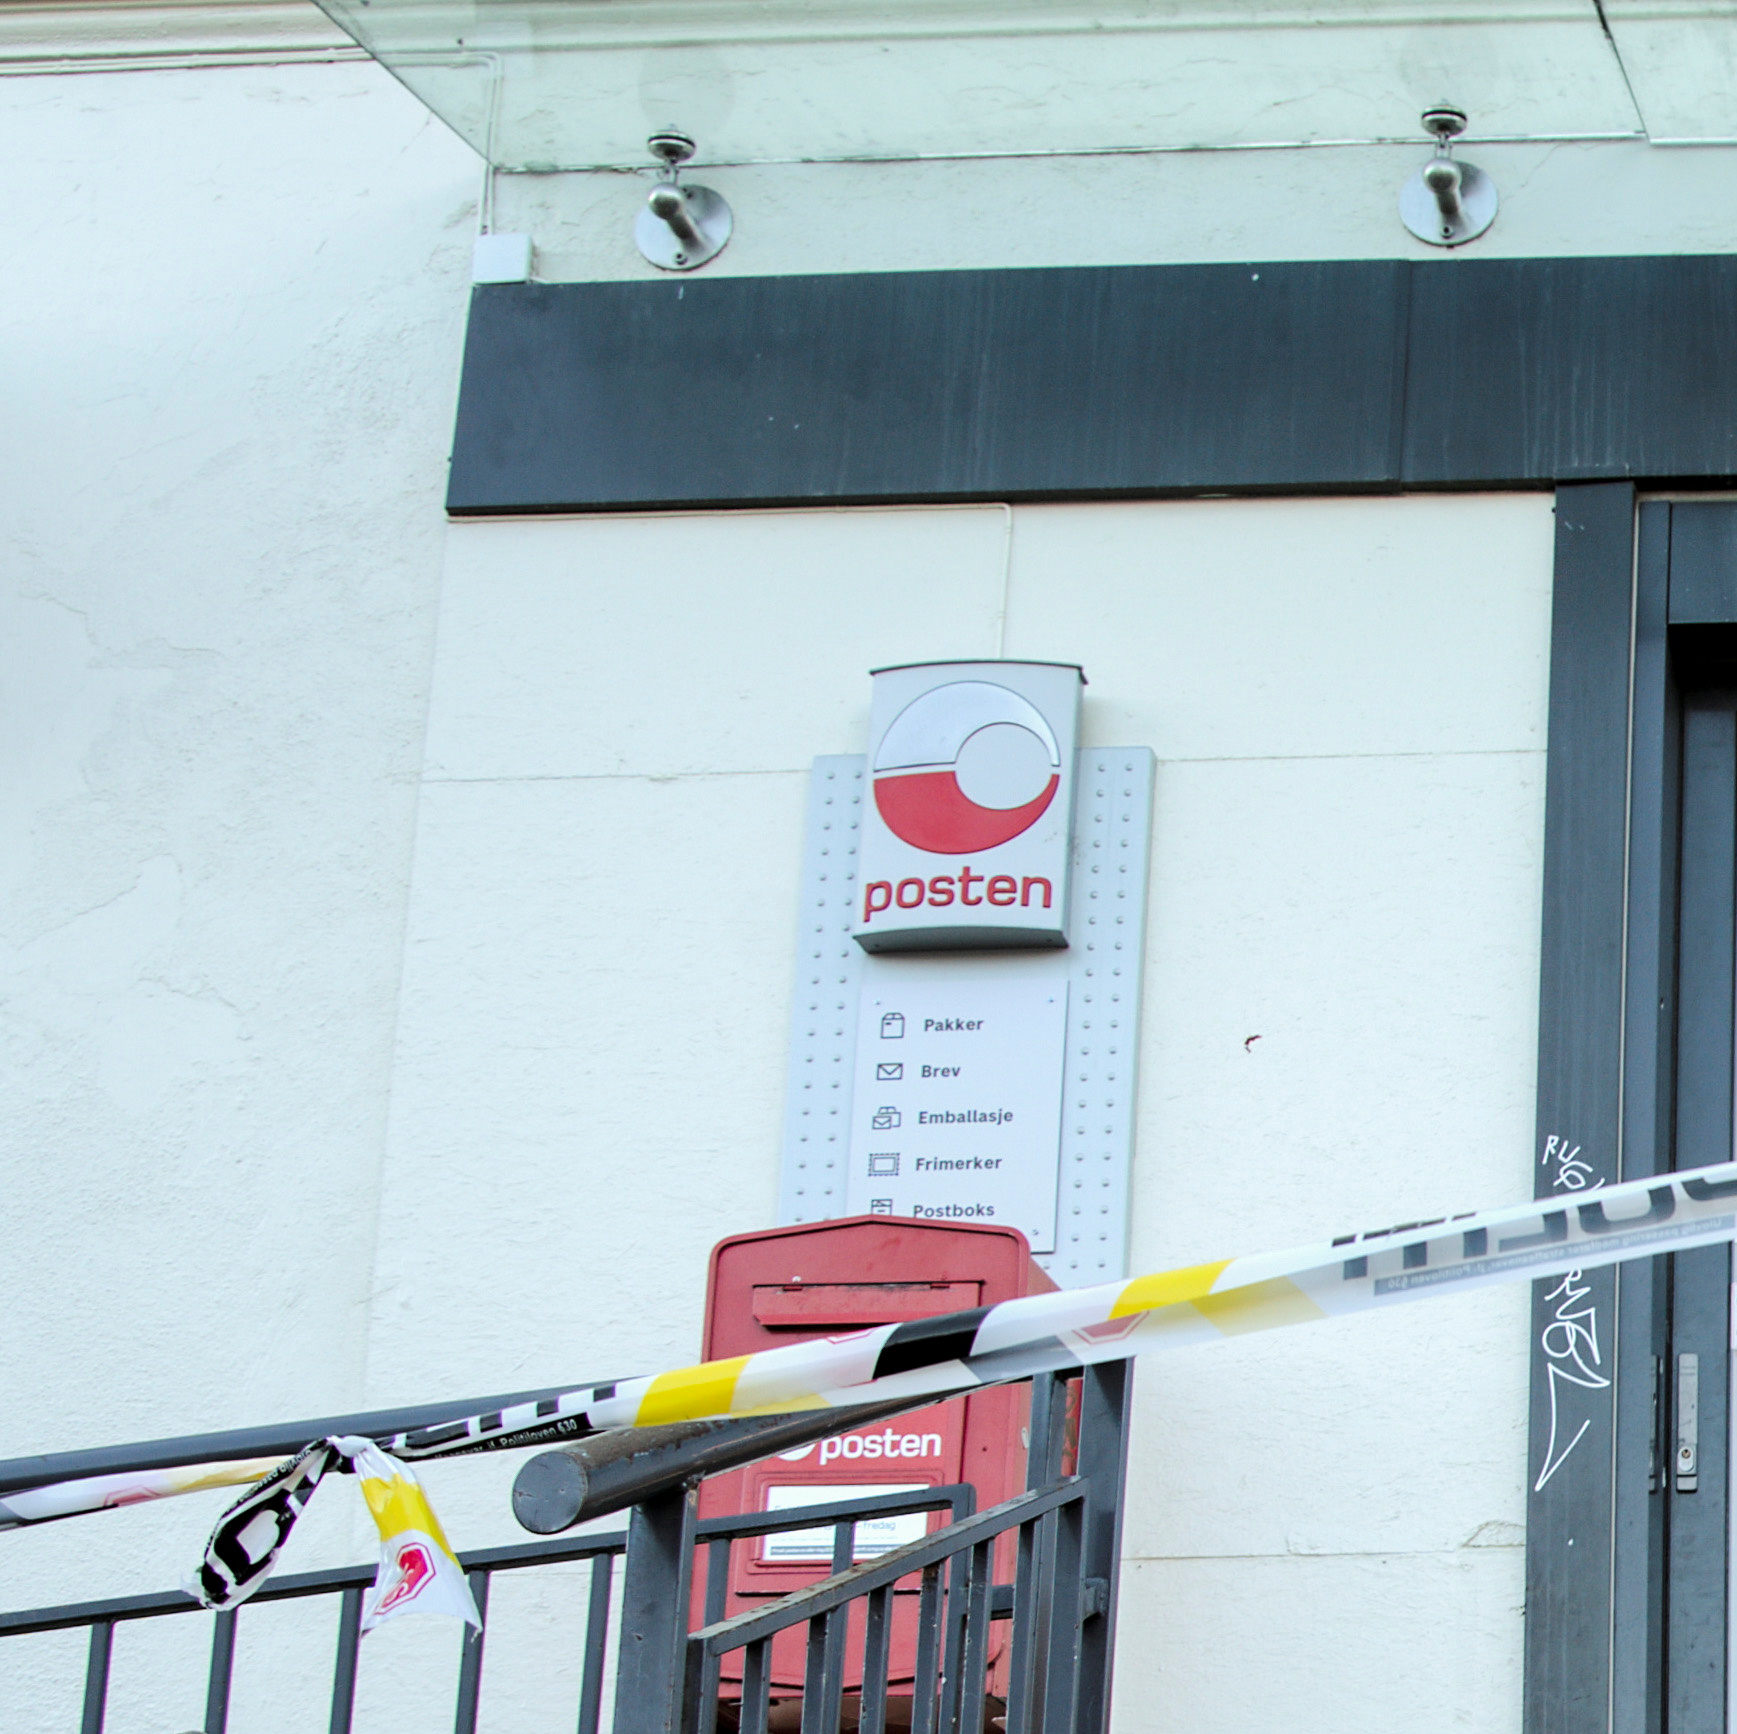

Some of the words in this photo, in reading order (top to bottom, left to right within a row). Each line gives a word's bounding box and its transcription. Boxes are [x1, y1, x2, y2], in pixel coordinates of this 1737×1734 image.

[862, 866, 1053, 922] posten
[923, 1018, 985, 1033] Pakker
[921, 1064, 961, 1079] Brev
[918, 1107, 1014, 1126] Emballasje
[915, 1156, 1003, 1172] Frimerker
[913, 1203, 996, 1220] Postboks
[819, 1427, 942, 1466] posten
